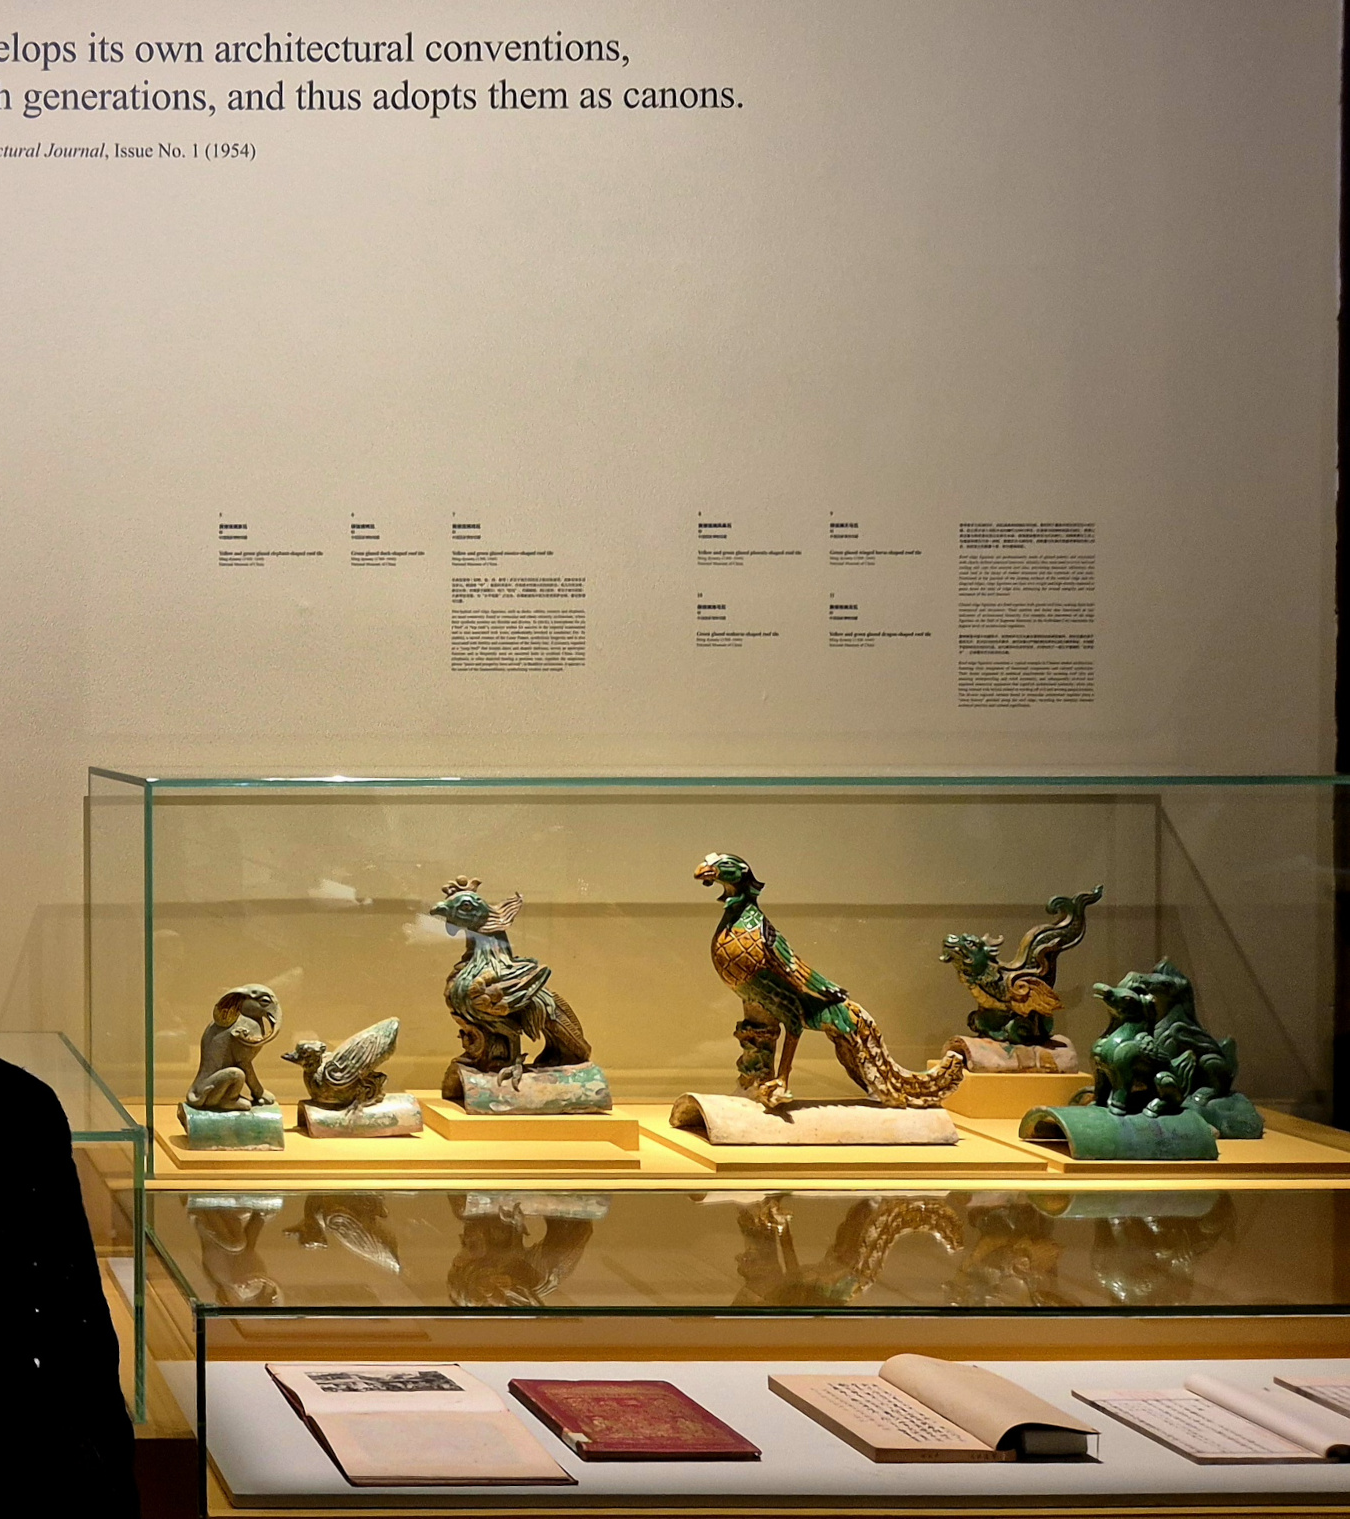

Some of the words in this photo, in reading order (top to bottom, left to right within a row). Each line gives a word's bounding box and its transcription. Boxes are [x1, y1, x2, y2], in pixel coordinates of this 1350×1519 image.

[89, 32, 123, 62] its
[136, 42, 204, 62] own
[215, 32, 414, 62] architectural
[426, 31, 629, 67] conventions,
[23, 80, 215, 118] generations,
[228, 80, 285, 110] and
[296, 80, 361, 110] thus
[373, 80, 476, 118] adopts
[488, 79, 568, 109] them
[580, 88, 612, 109] as
[624, 88, 742, 108] canons.
[45, 143, 109, 161] Journal,
[114, 143, 154, 159] Issue
[158, 143, 186, 159] No.
[193, 143, 199, 159] 1
[205, 143, 256, 161] (1954)
